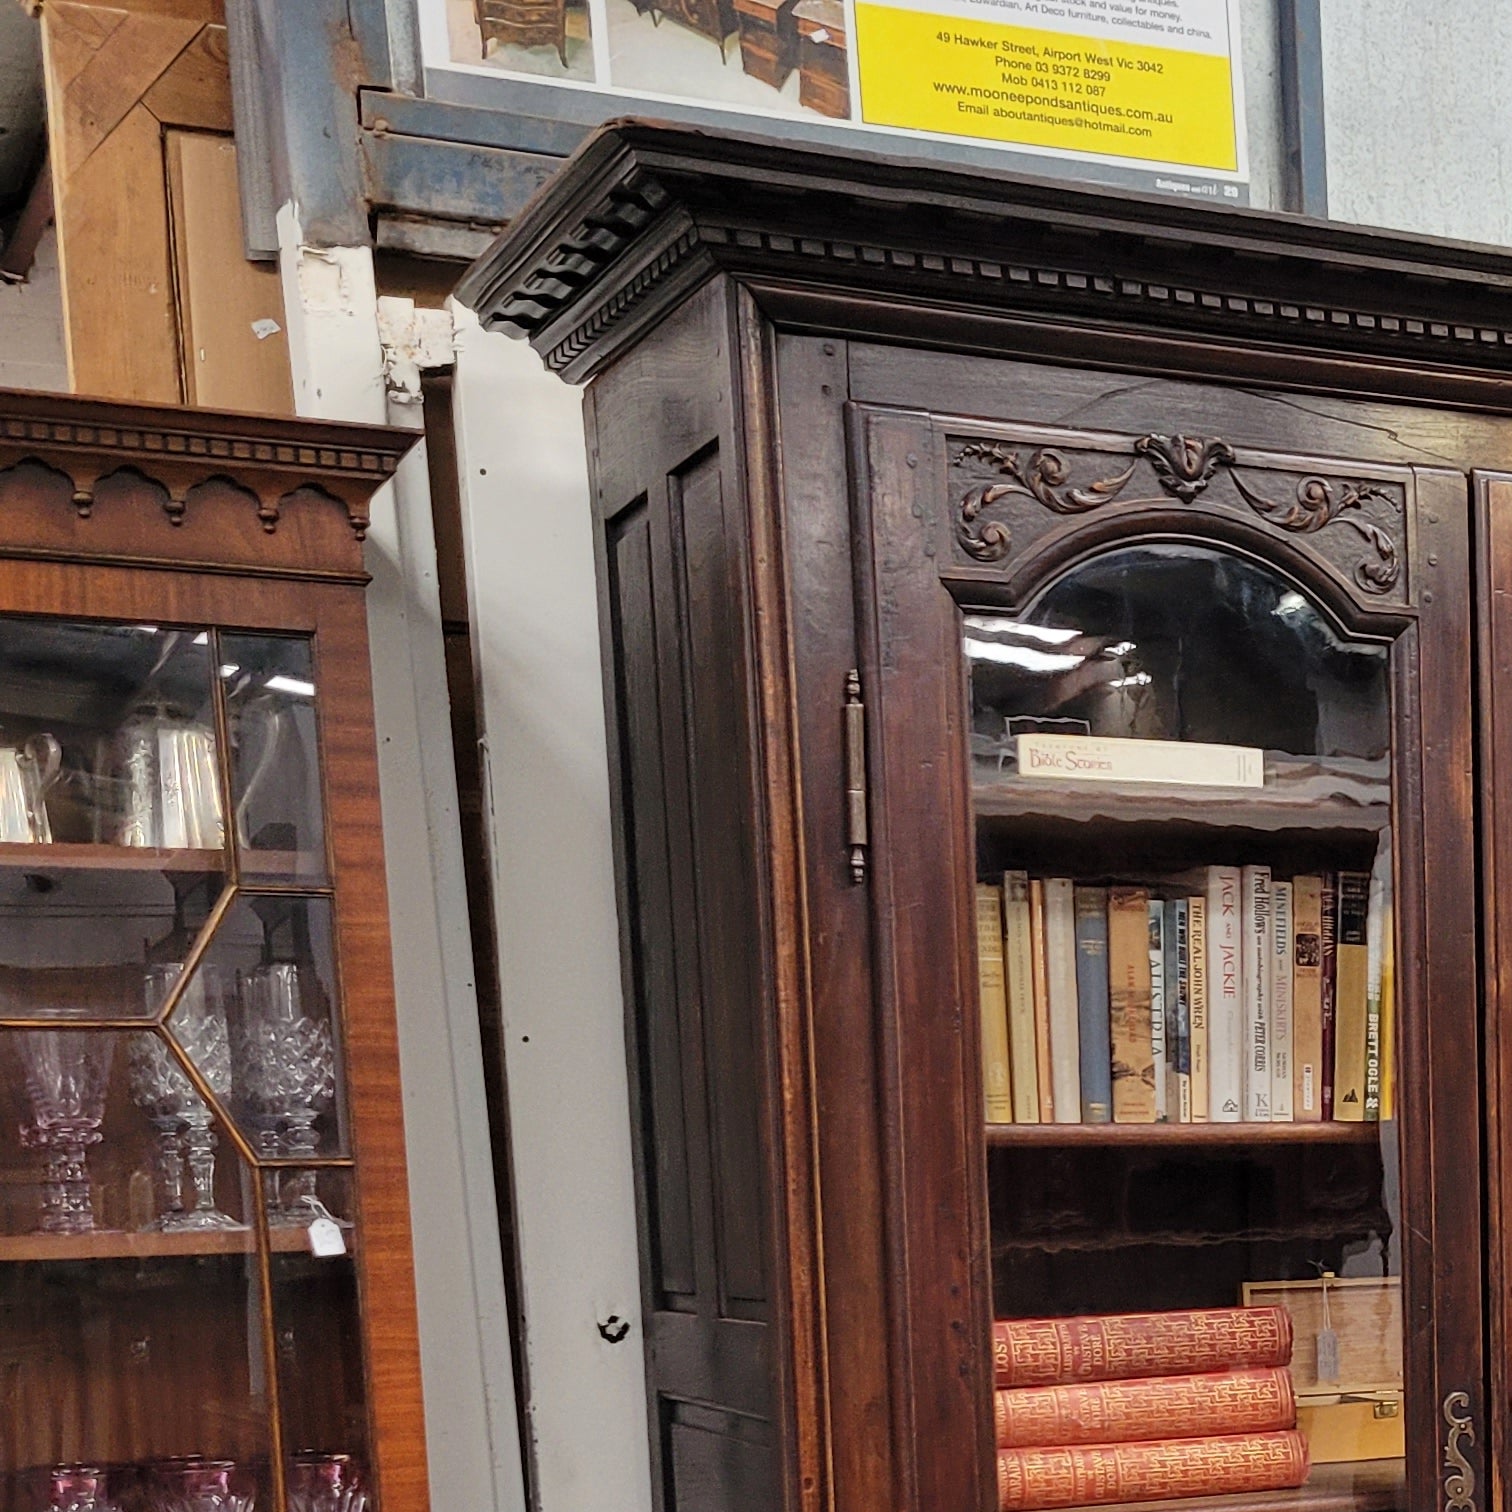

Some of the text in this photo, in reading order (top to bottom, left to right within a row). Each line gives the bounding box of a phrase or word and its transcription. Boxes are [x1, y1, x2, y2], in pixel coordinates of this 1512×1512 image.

[1041, 6, 1065, 19] Deco
[1111, 17, 1164, 32] collectables
[1167, 24, 1184, 35] and
[936, 31, 1163, 74] 49 Hawker Street, Airport West Vic 3042
[995, 56, 1111, 82] Phone 03 9372 8299
[933, 81, 1173, 124] www.mooneepondsantiques.com.au
[1001, 73, 1106, 97] Mob 0413 112 087
[958, 102, 1152, 137] Email aboutantiques@hotmail.com
[1220, 876, 1235, 916] JACK
[1254, 871, 1271, 894] Fred
[1255, 897, 1271, 934] Hollows
[1192, 904, 1204, 1030] THE REAL JOHN WREN
[1220, 944, 1236, 999] JACKIE
[1276, 887, 1286, 1040] MINEFIELDS MINISKIRTS
[1254, 1021, 1267, 1044] PETER
[1368, 1013, 1379, 1056] BRETT
[1368, 1059, 1379, 1093] OGLE
[995, 1336, 1009, 1373] LOST
[1080, 1324, 1092, 1375] GUSTAVE
